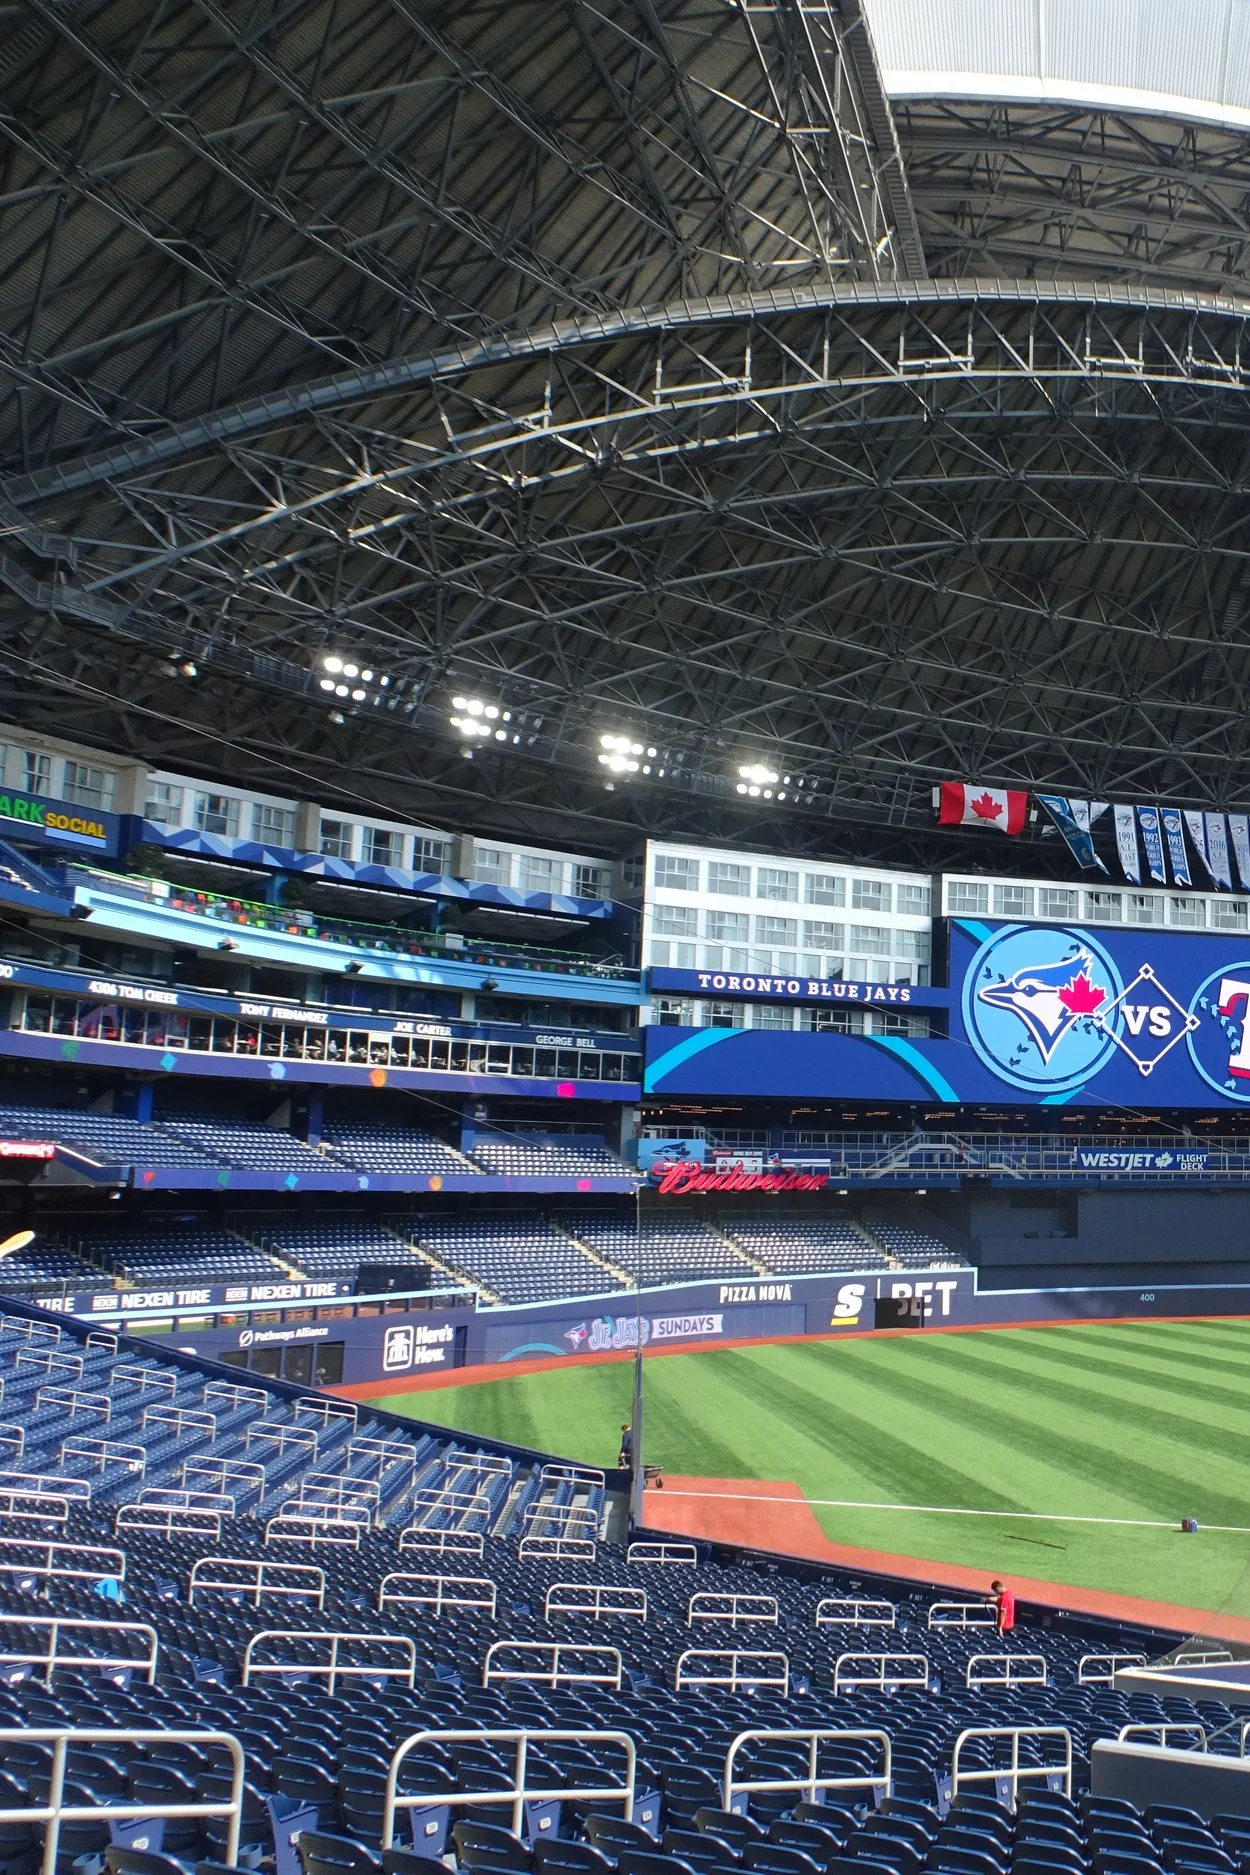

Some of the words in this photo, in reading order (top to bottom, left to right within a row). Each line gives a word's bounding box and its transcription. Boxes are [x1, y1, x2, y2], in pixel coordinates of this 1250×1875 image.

[45, 812, 107, 839] SOCIAL
[1118, 832, 1134, 842] 1991
[1143, 832, 1159, 843] 1992
[1167, 834, 1181, 846] 1993
[1209, 839, 1226, 850] 2016
[118, 985, 144, 1000] TOM
[145, 988, 179, 1005] CHEEK
[698, 974, 800, 994] TORONTO
[807, 981, 859, 998] BLUE
[864, 986, 911, 1002] JAYS
[239, 1003, 270, 1017] TONY
[272, 1007, 329, 1025] FERNANDEZ
[1121, 1004, 1172, 1037] VS
[393, 1021, 414, 1033] JOE
[416, 1023, 453, 1037] CARTER
[535, 1034, 573, 1047] GEORGE
[576, 1037, 596, 1049] BELL
[1080, 1153, 1154, 1171] WESTJET
[1176, 1154, 1208, 1163] FLIGHT
[1180, 1162, 1204, 1171] DECK
[651, 1160, 829, 1194] Budweiser
[121, 1291, 175, 1309] NEXEN
[176, 1289, 212, 1305] TIRE
[251, 1284, 302, 1301] NEXEN
[303, 1282, 338, 1298] TIRE
[719, 1285, 756, 1304] PIZZA
[759, 1283, 791, 1301] NOVA
[891, 1280, 958, 1317] BET
[1139, 1293, 1155, 1302] 400
[254, 1330, 295, 1342] Pathways
[296, 1326, 329, 1339] Alliance
[415, 1323, 454, 1345] Here's
[658, 1316, 714, 1335] SUNDAYS
